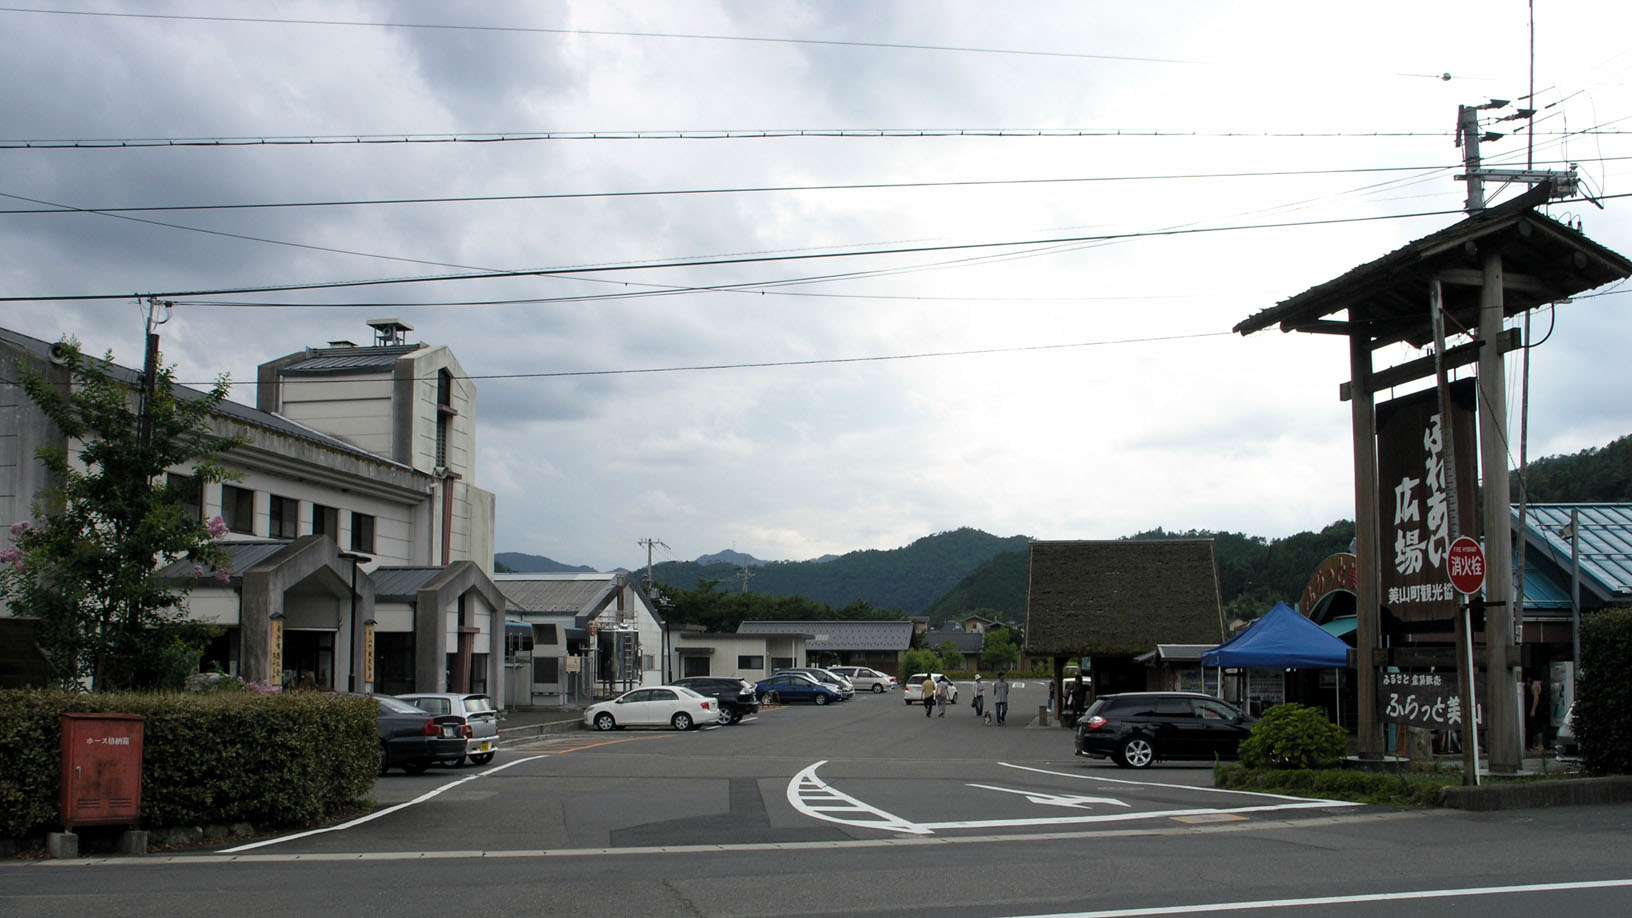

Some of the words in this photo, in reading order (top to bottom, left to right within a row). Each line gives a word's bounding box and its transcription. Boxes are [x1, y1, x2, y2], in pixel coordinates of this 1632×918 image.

[1394, 476, 1427, 575] 広場
[1451, 555, 1482, 576] 消火栓
